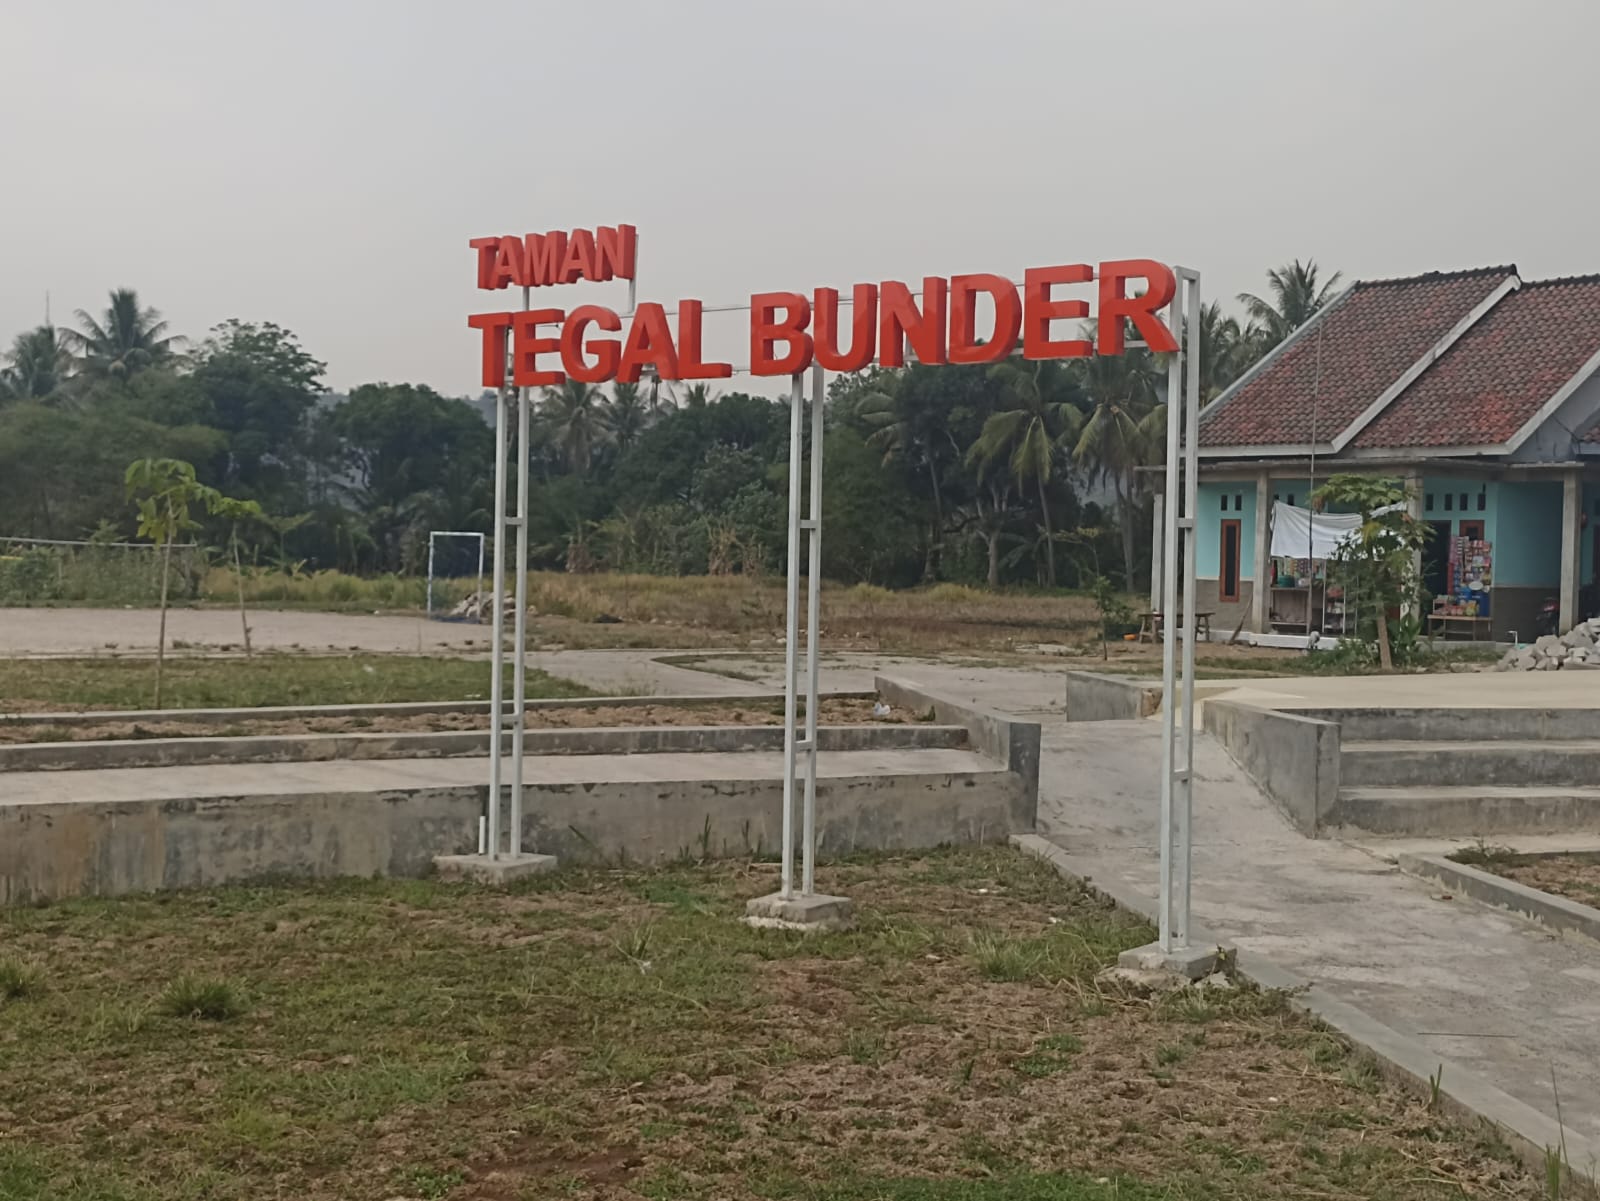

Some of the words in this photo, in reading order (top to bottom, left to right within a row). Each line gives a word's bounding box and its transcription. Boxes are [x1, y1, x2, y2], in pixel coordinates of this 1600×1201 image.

[469, 224, 637, 289] TAMAN
[468, 300, 732, 388] TEGAL
[750, 259, 1180, 376] BUNDER
